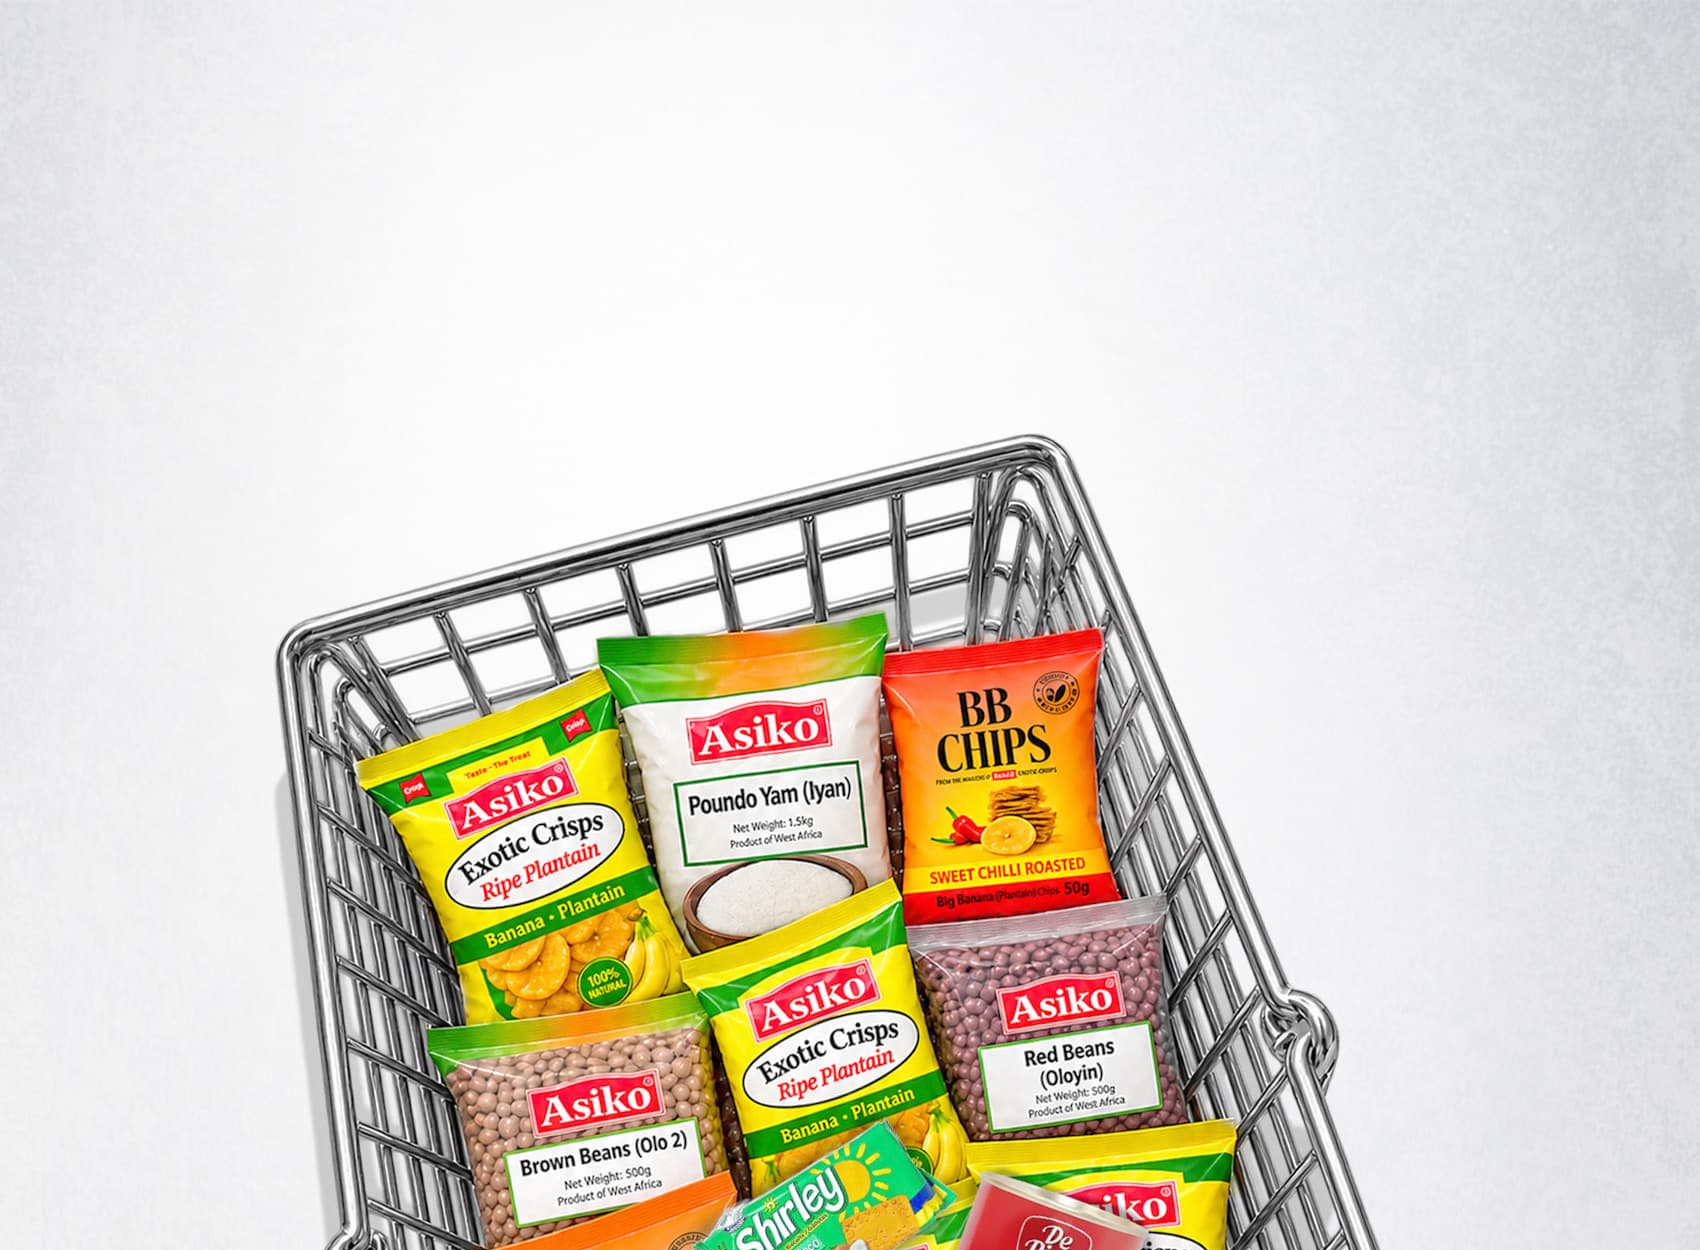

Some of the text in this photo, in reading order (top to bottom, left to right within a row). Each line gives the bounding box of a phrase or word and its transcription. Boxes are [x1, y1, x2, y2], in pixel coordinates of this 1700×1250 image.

[957, 687, 1012, 728] BB
[698, 714, 818, 756] Asiko
[937, 725, 1051, 773] CHIPS
[462, 775, 564, 830] Asiko
[688, 777, 852, 816] Poundo Yam (Iyan)
[730, 829, 823, 849] Product of West Africa
[733, 815, 814, 833] Net Weight: 1.5kg
[457, 810, 605, 886] Exotic Crisps
[480, 841, 601, 903] Ripe Plantain
[929, 857, 1086, 885] SWEET CHILLI ROASTED
[936, 896, 955, 909] Big
[957, 892, 994, 906] Banana
[1064, 880, 1090, 897] 50g
[484, 884, 626, 950] Banana Plantain
[587, 968, 621, 987] 100%
[587, 978, 627, 999] NATURAL
[760, 977, 866, 1032] Asiko
[1010, 986, 1113, 1025] Asiko
[756, 1021, 900, 1084] Exotic Crisps
[1024, 1040, 1114, 1067] Red Beans
[778, 1049, 895, 1102] Ripe Plantain
[1036, 1085, 1116, 1104] Net Weight: 500g
[1040, 1063, 1103, 1090] (Oloyin)
[541, 1086, 650, 1128] Asiko
[780, 1089, 915, 1145] Banana Plantain
[1028, 1096, 1125, 1119] Product of West Africa
[520, 1130, 687, 1177] Brown Beans (Olo 2)
[557, 1178, 662, 1207] Product of West Africa
[564, 1166, 652, 1191] Net Weight: 500g
[1103, 1193, 1167, 1221] iko
[1042, 1224, 1074, 1250] De
